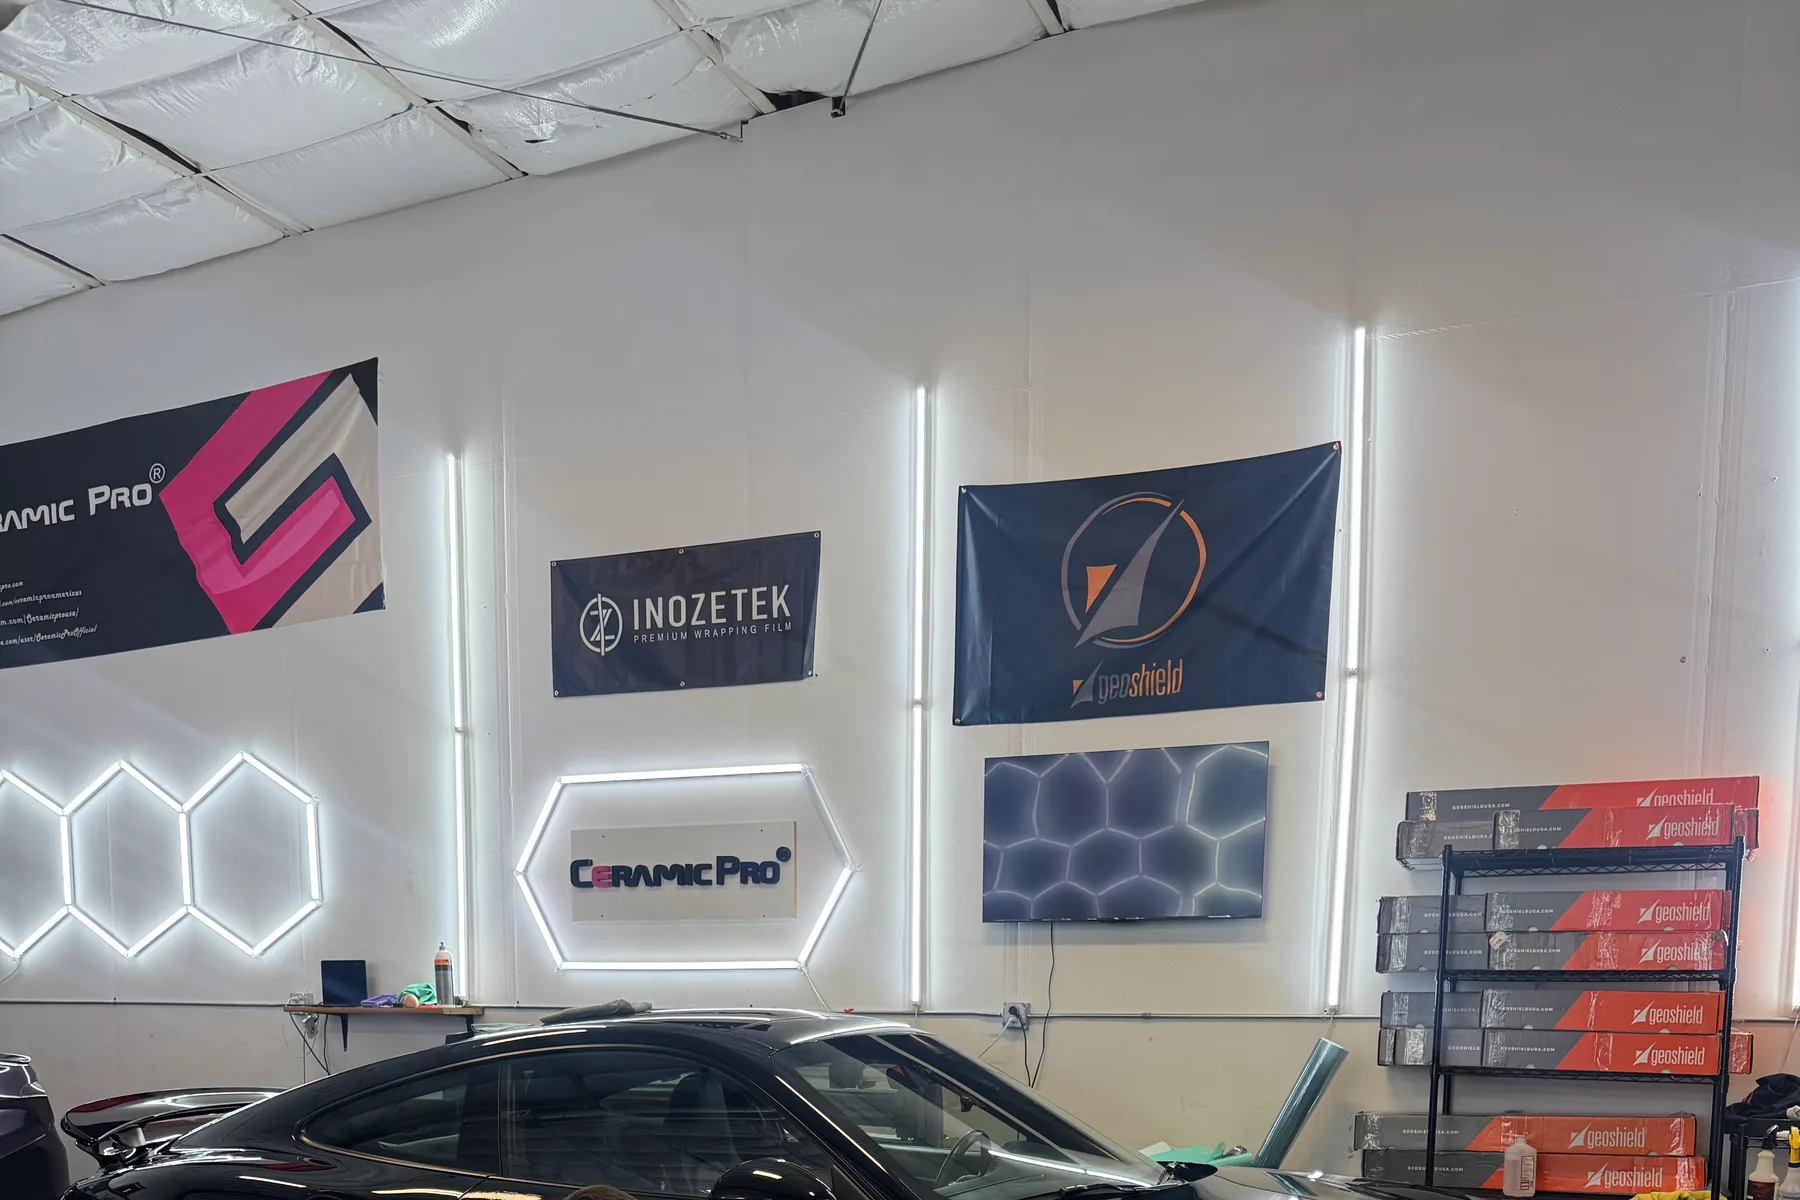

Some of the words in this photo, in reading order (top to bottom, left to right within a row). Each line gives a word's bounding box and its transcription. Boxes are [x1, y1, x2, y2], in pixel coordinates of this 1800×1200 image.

[633, 584, 791, 630] INOZETEK
[633, 631, 688, 644] PREMIUM
[694, 625, 757, 638] WRAPPING
[764, 621, 793, 632] FILM
[1098, 659, 1183, 704] geoshield
[1663, 816, 1719, 840] geoshield
[570, 858, 713, 888] CERAMIC
[1655, 901, 1711, 924] geoshield
[1649, 1005, 1704, 1026] geoshield
[1650, 1046, 1706, 1067] geoshield
[1587, 1126, 1645, 1150] geoshield
[1604, 1166, 1663, 1189] geoshield
